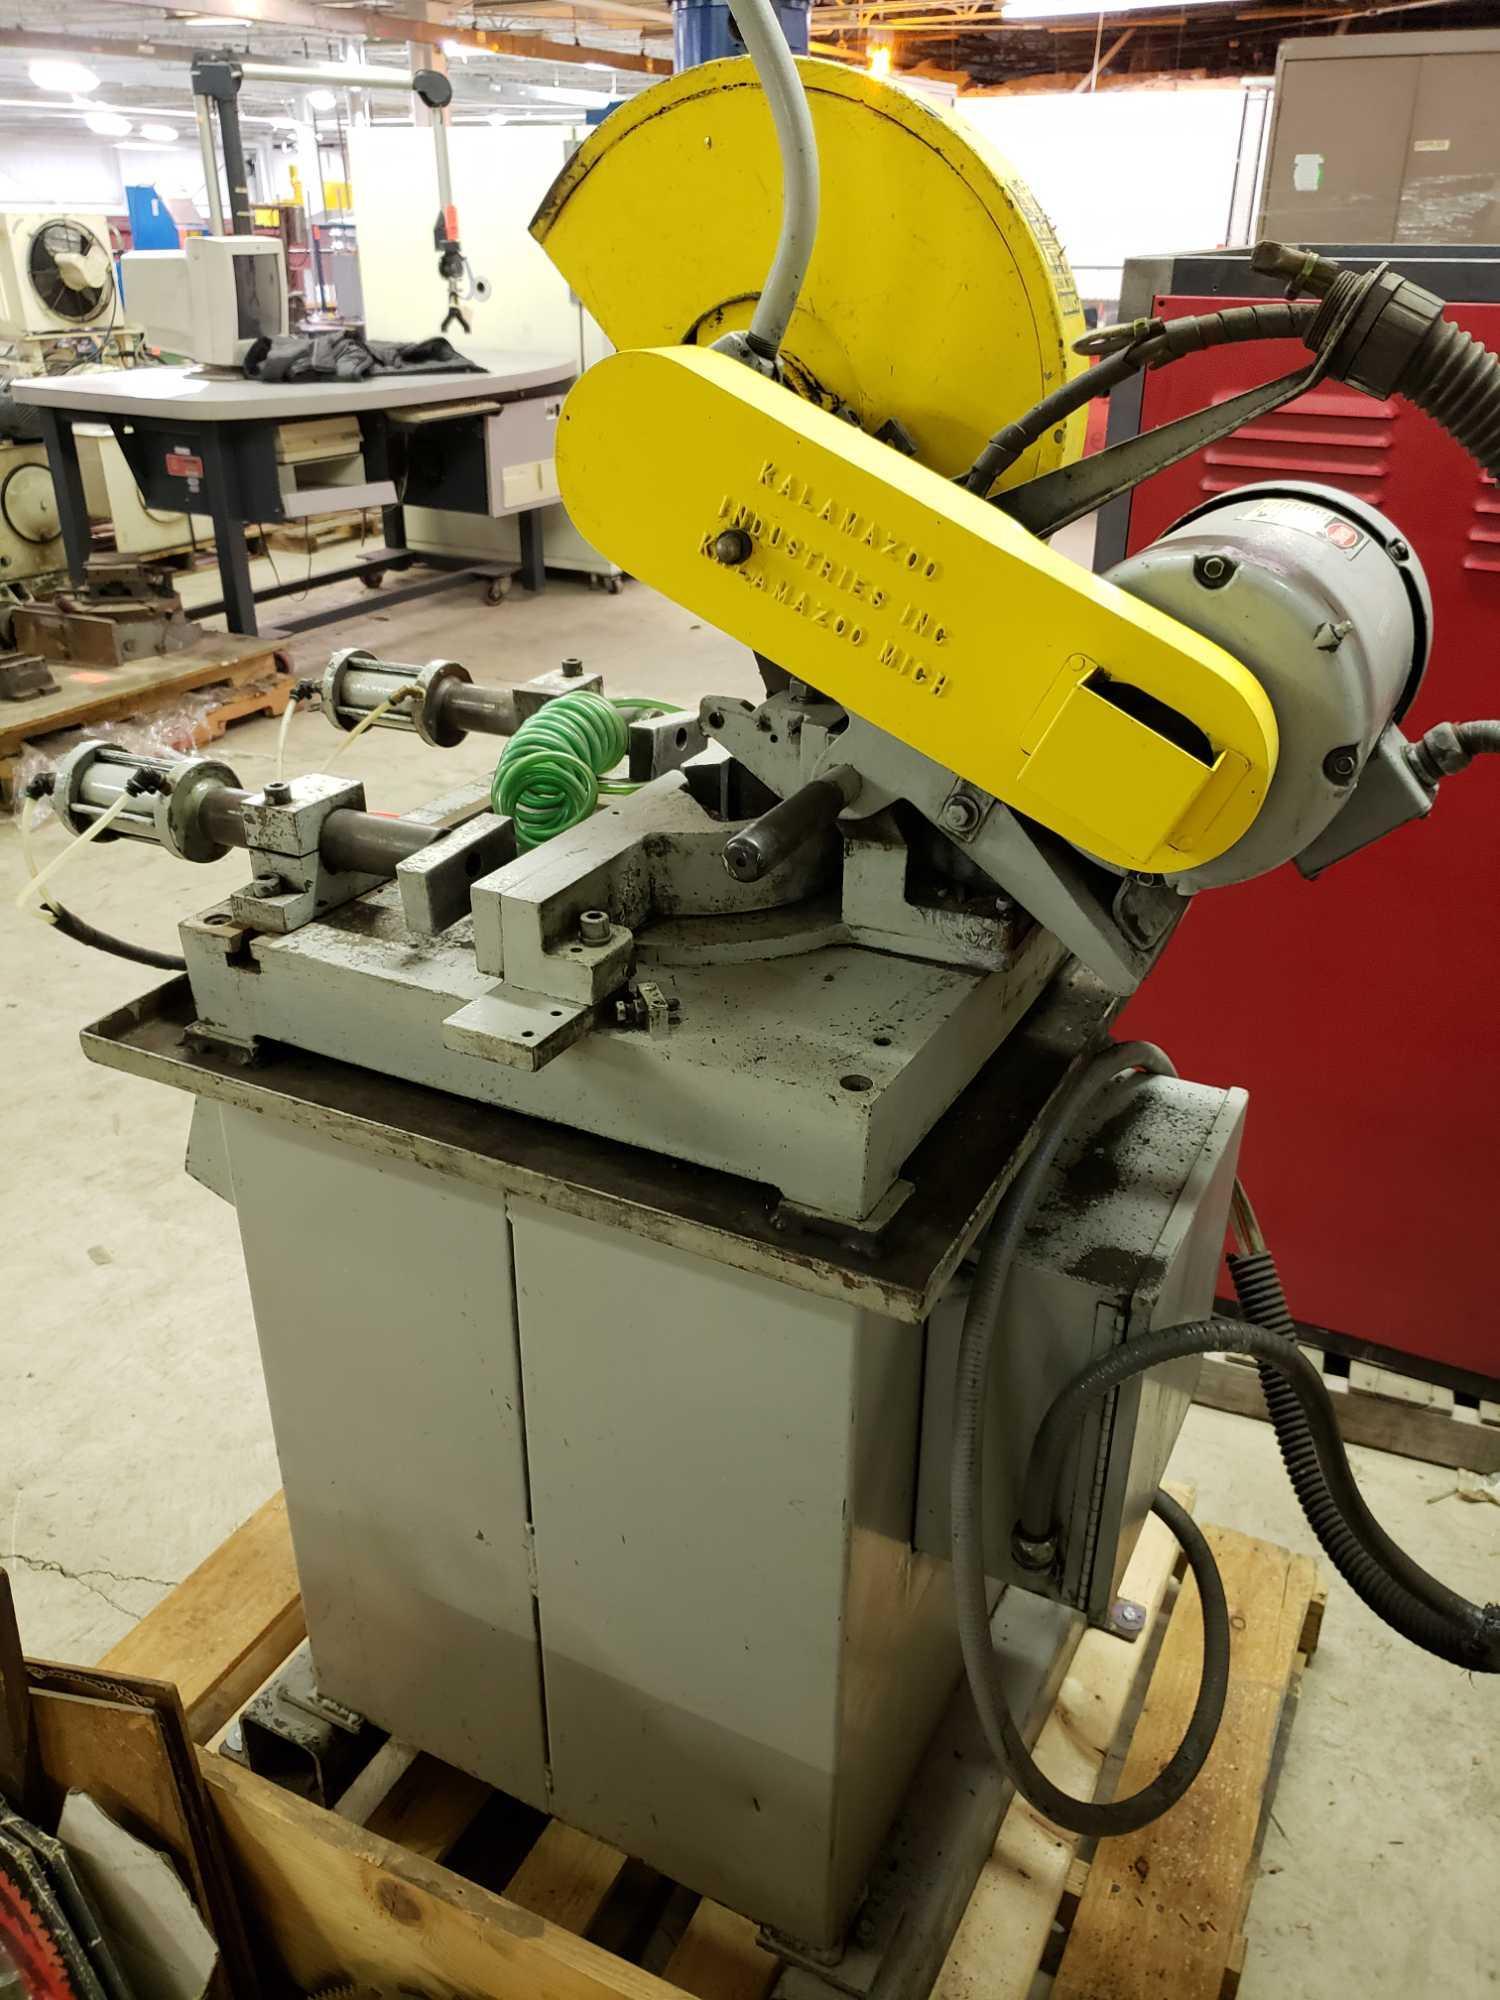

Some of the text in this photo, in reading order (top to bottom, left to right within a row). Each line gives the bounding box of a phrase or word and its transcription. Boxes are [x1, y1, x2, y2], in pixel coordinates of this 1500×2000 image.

[718, 495, 948, 645] INDUSTRIES INC
[758, 460, 939, 579] KALAMAZOO
[699, 529, 950, 697] KLAMAZOO MICH
